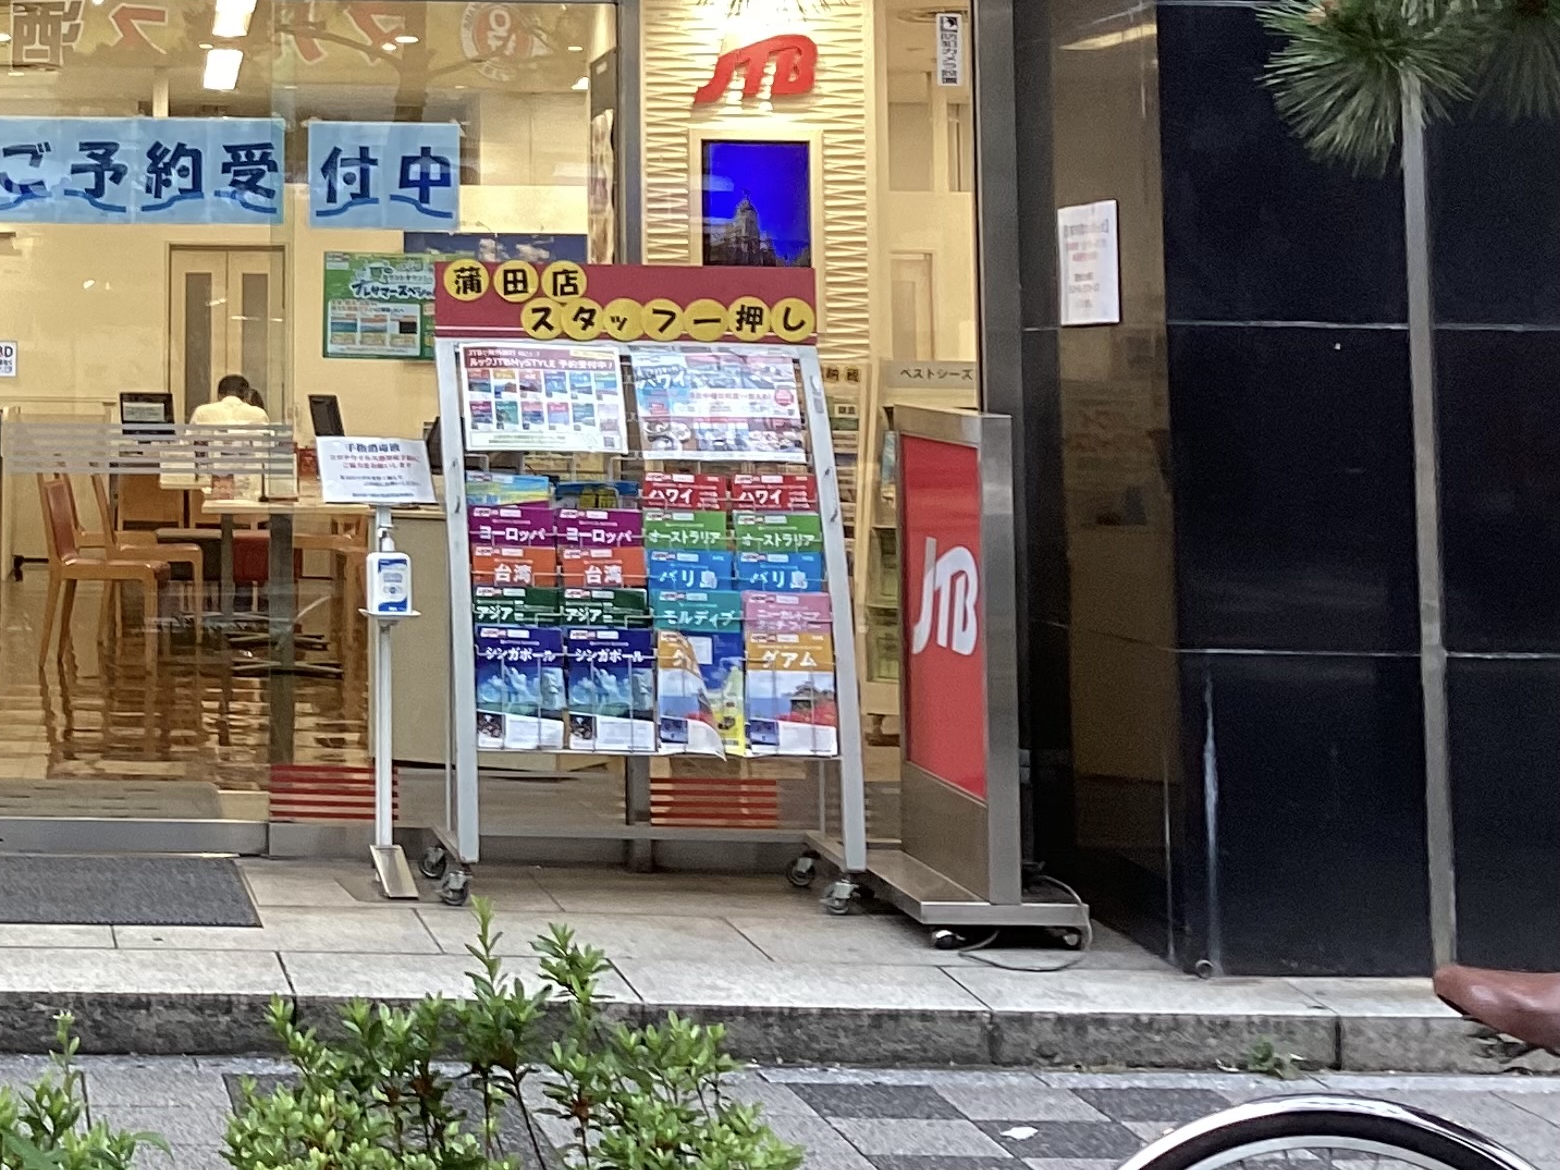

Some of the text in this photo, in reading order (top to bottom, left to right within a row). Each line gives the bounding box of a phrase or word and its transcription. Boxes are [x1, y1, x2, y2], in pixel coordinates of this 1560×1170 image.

[694, 34, 818, 105] JTB
[454, 267, 579, 297] 蒲田店
[649, 489, 693, 505] ハワイ
[740, 489, 782, 505] ハワイ
[479, 525, 546, 542] ヨーロッパ
[566, 527, 633, 543] ヨーロッパ
[649, 530, 722, 545] オーストラリア
[742, 533, 815, 548] オーストラリア
[494, 563, 532, 584] 台湾
[586, 565, 623, 585] 台湾
[659, 569, 718, 589] バリ島
[750, 571, 808, 590] バリ島
[912, 536, 979, 656] JTB
[476, 606, 513, 620] アジア
[565, 608, 602, 622] アジア
[663, 610, 736, 626] モルディブ
[486, 647, 556, 662] シンガポール
[575, 648, 644, 663] シンガポール
[763, 651, 817, 668] グアム
